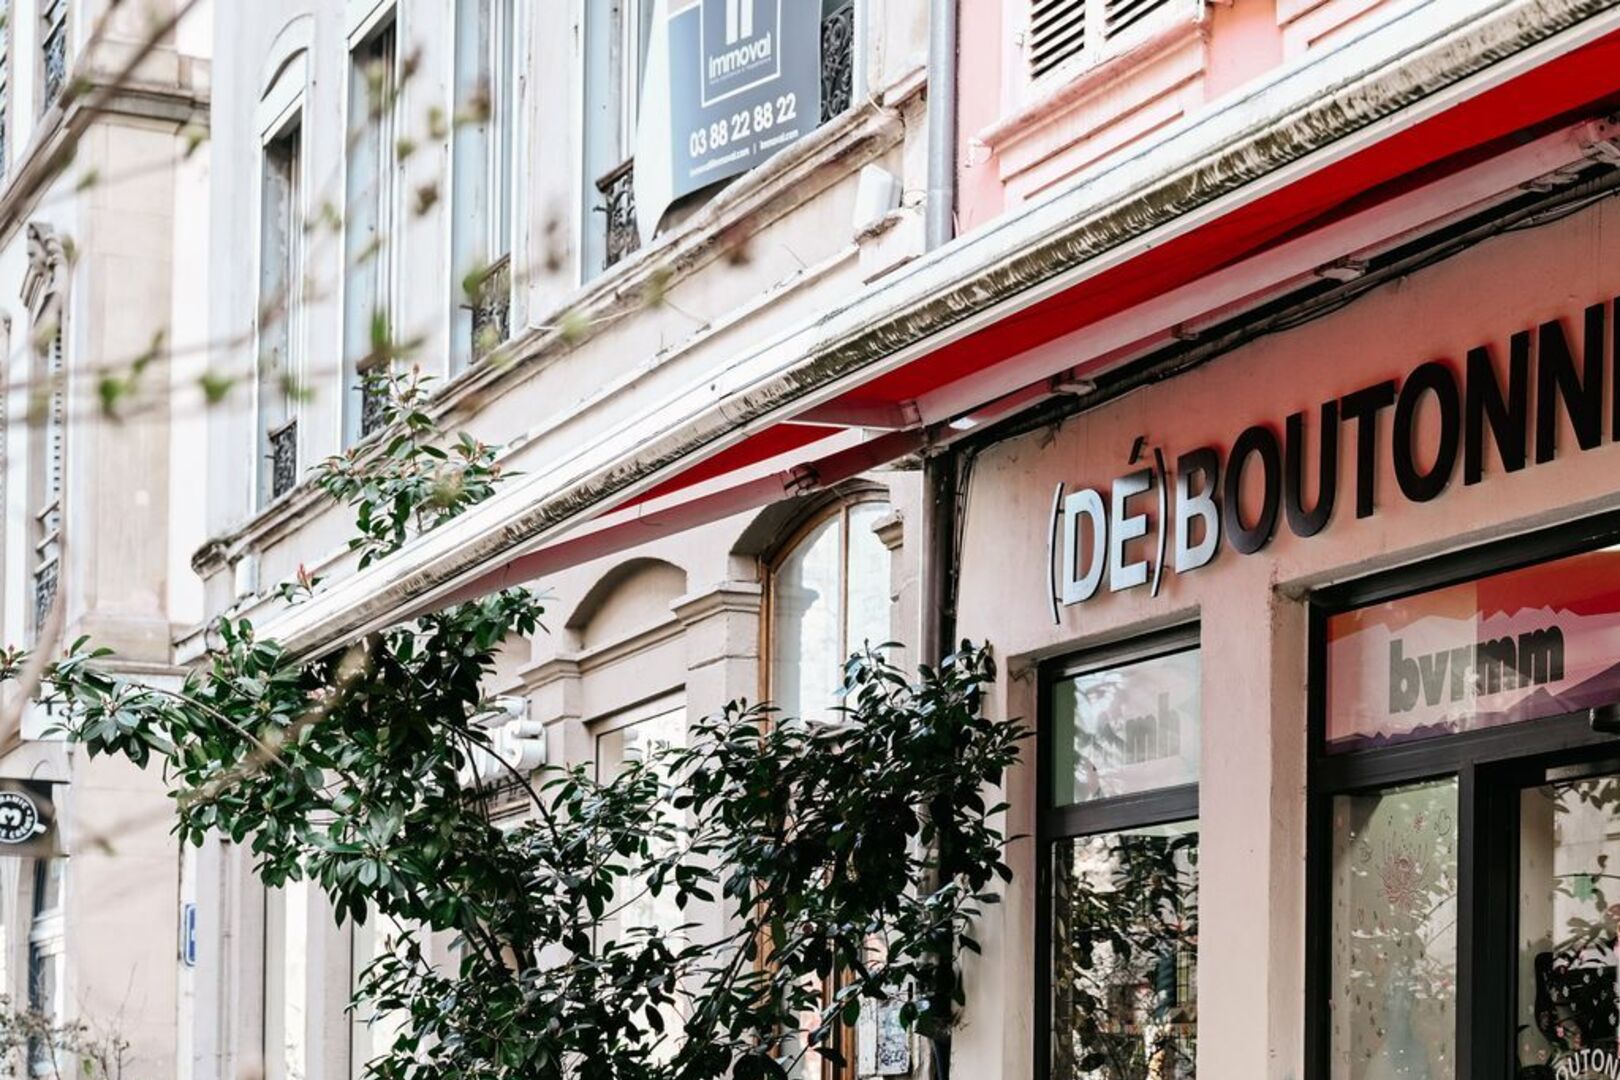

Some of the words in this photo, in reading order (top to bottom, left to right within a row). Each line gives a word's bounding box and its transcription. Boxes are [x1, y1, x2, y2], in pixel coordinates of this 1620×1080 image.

[689, 128, 707, 157] 03
[710, 120, 728, 149] 88
[731, 110, 750, 141] 22
[754, 102, 773, 132] 88
[776, 93, 796, 124] 22
[1387, 622, 1565, 716] bvrmm
